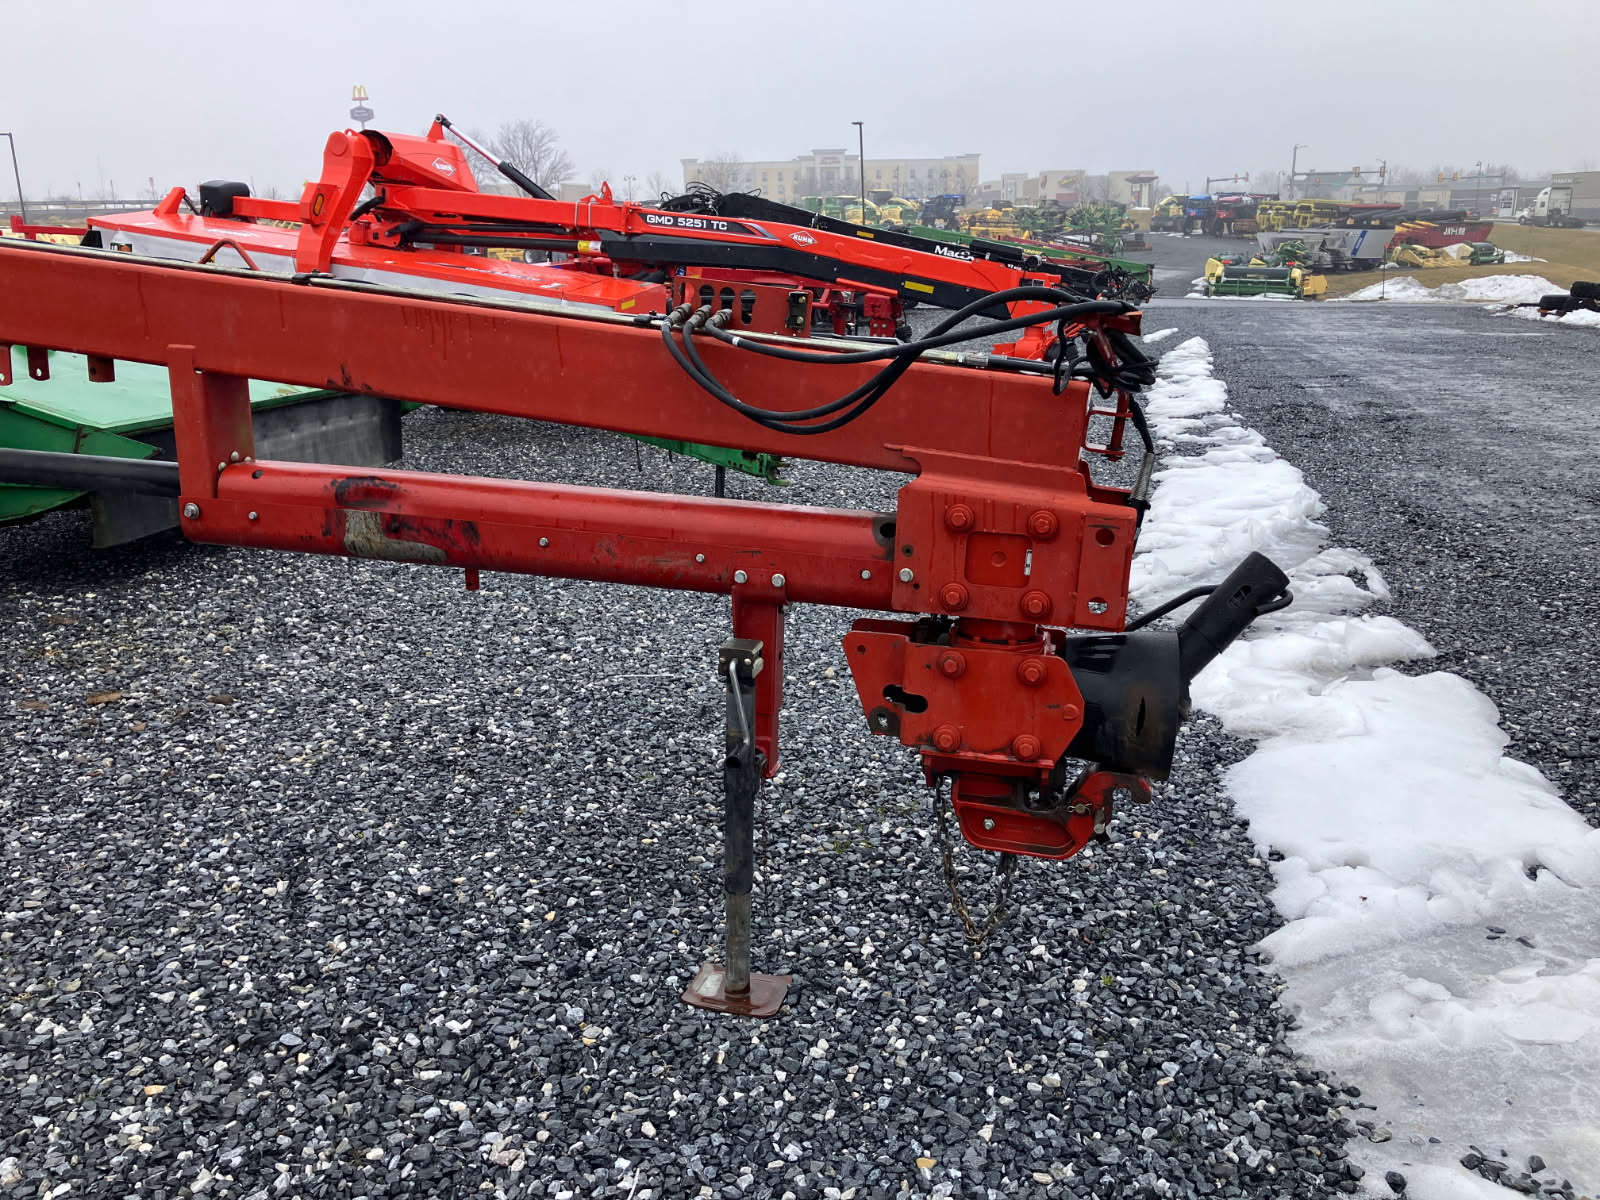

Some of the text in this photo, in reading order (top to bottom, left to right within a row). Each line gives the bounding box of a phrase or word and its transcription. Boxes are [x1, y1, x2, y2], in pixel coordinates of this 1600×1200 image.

[646, 214, 728, 231] GMD 5251 TC
[792, 234, 813, 244] KUHN
